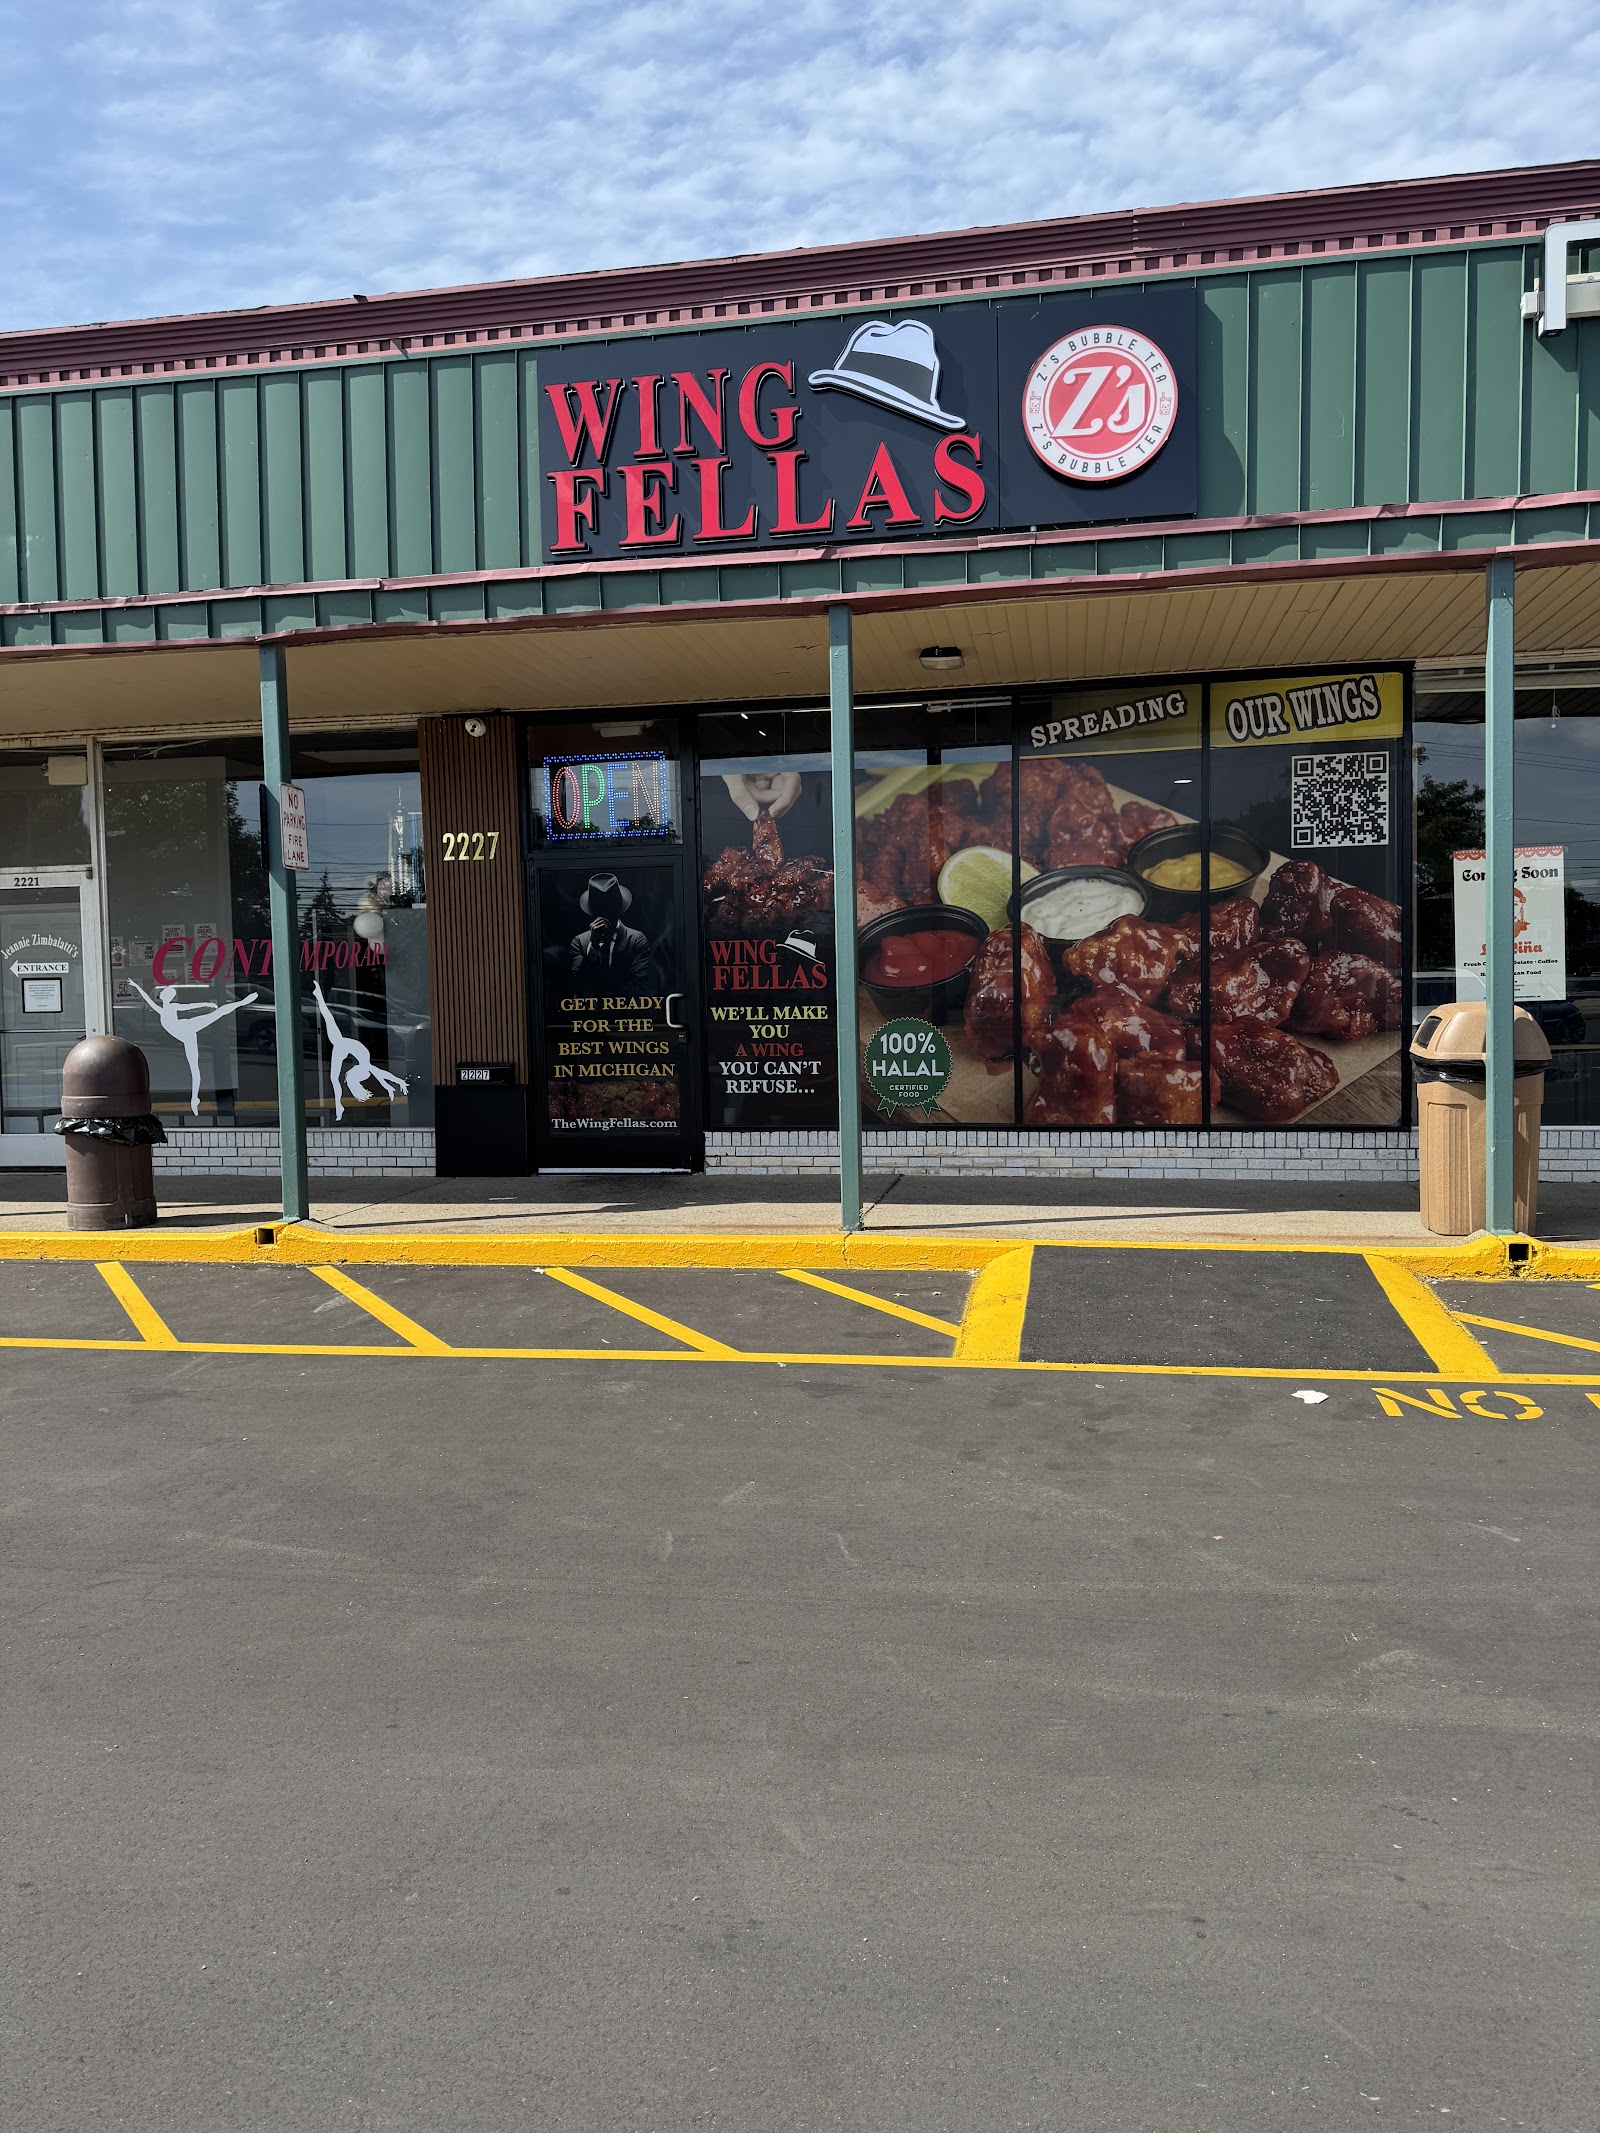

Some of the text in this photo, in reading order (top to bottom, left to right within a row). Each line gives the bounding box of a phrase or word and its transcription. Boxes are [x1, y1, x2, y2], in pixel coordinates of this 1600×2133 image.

[1036, 332, 1167, 383] Z'S BUBBLE TEA
[1050, 364, 1146, 438] Z's
[545, 361, 801, 467] WING
[1031, 423, 1164, 474] Z'S BUBBLE TEA
[547, 431, 987, 555] FELLAS
[1227, 677, 1379, 741] OUR WINGS
[1030, 692, 1186, 749] SPREADING
[287, 793, 299, 810] NO
[552, 761, 660, 830] OPEN
[283, 811, 306, 831] PARKING
[288, 834, 303, 847] FIRE
[442, 831, 500, 862] 2227
[287, 848, 305, 863] LANE
[1521, 866, 1559, 879] Soon
[14, 877, 40, 887] 2221
[0, 933, 79, 960] Jeannie Zimbalatti's
[709, 939, 778, 965] WING
[17, 963, 68, 972] ENTRANCE
[152, 936, 391, 986] CONTMPORARY
[712, 963, 828, 991] FELLAS
[560, 996, 665, 1011] GET READY
[710, 1005, 829, 1021] WE'LL MAKE
[572, 1018, 654, 1033] FOR THE
[750, 1024, 790, 1039] YOU
[558, 1041, 670, 1056] BEST WINGS
[735, 1043, 805, 1057] A WING
[880, 1032, 936, 1055] 100%
[462, 1070, 489, 1080] 2227
[554, 1063, 676, 1078] IN MICHIGAN
[719, 1060, 822, 1076] YOU CAN'T
[872, 1059, 945, 1077] HALAL
[726, 1079, 815, 1094] REFUSE...
[551, 1117, 678, 1131] TheWingFellas.com
[1371, 1387, 1545, 1421] NO
